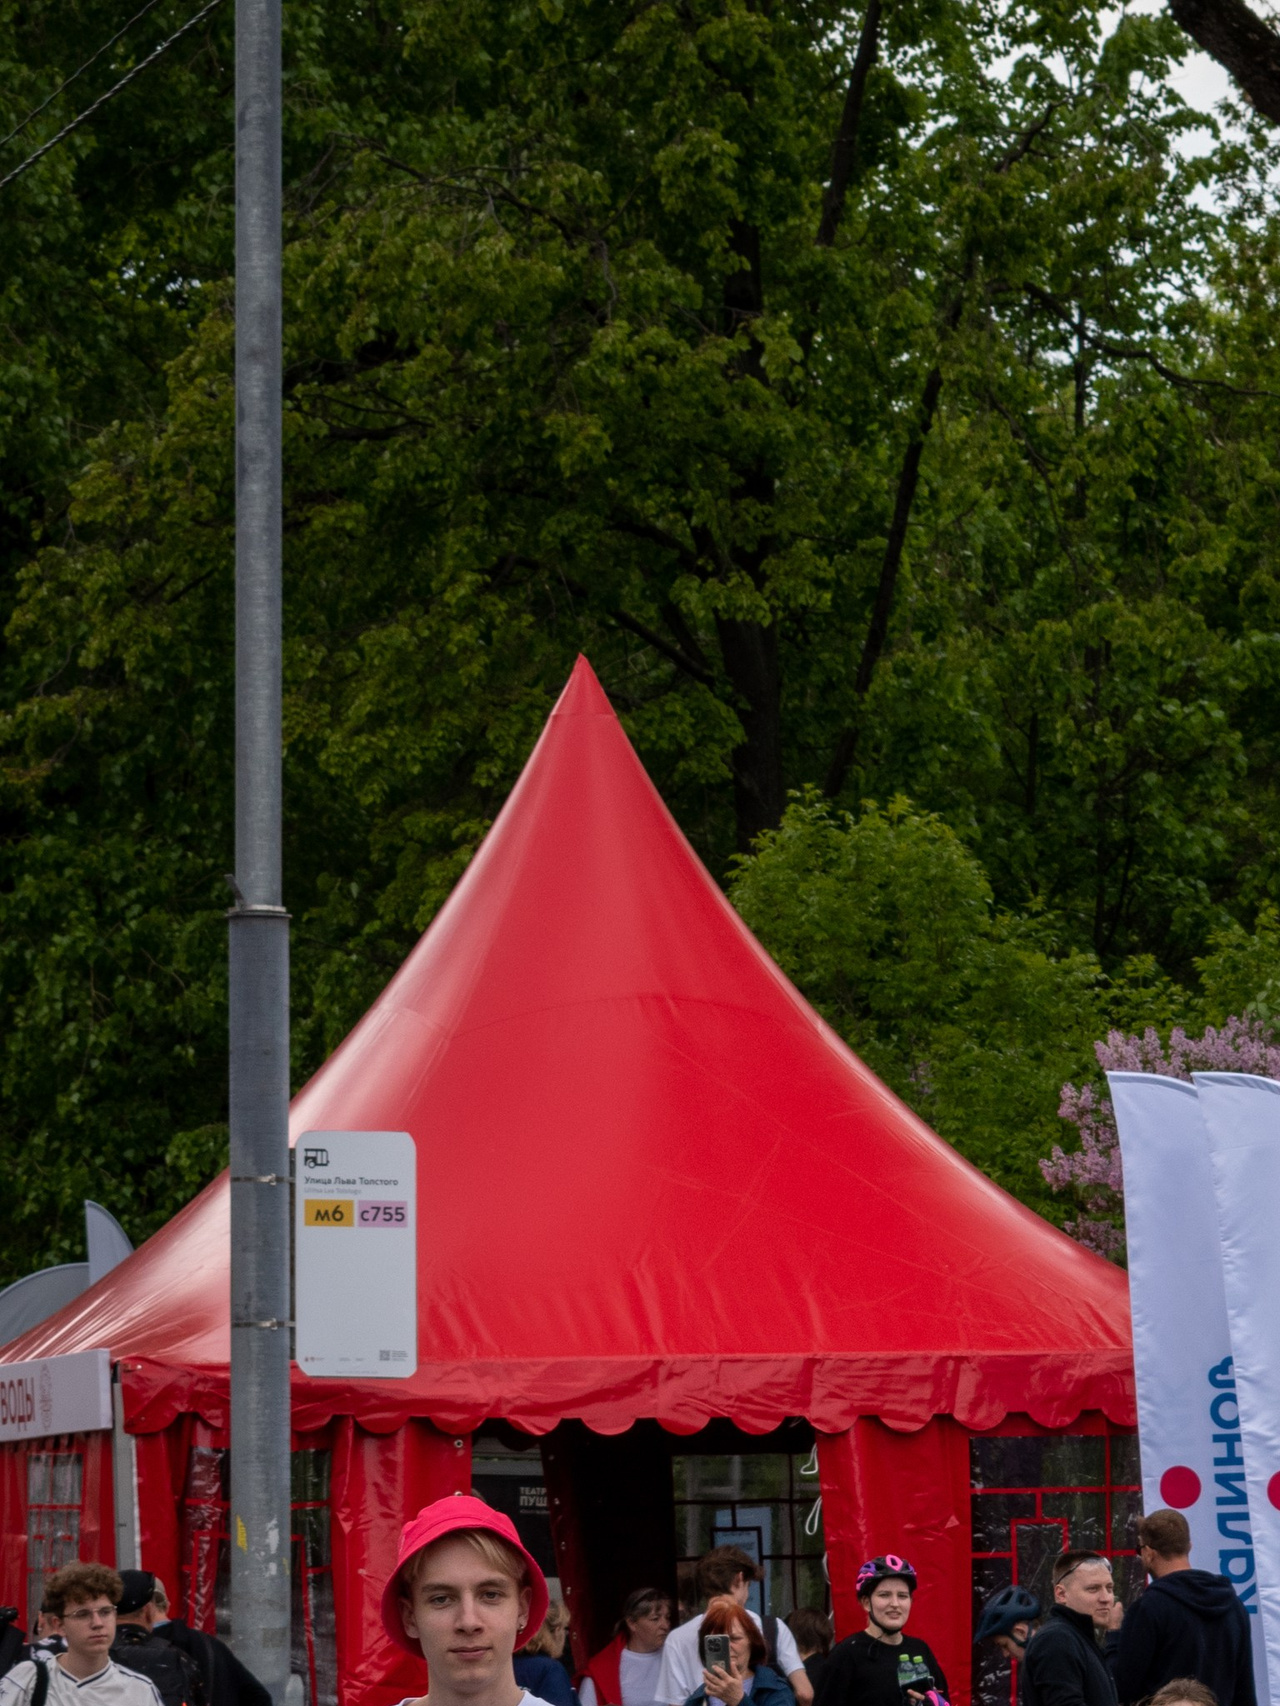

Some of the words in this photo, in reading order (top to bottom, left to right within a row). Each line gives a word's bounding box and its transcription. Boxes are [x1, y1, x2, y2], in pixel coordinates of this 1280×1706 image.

[304, 1176, 332, 1186] Улица
[334, 1176, 357, 1186] Льва
[359, 1177, 399, 1187] Толстого
[520, 1487, 547, 1495] ТЕАТР
